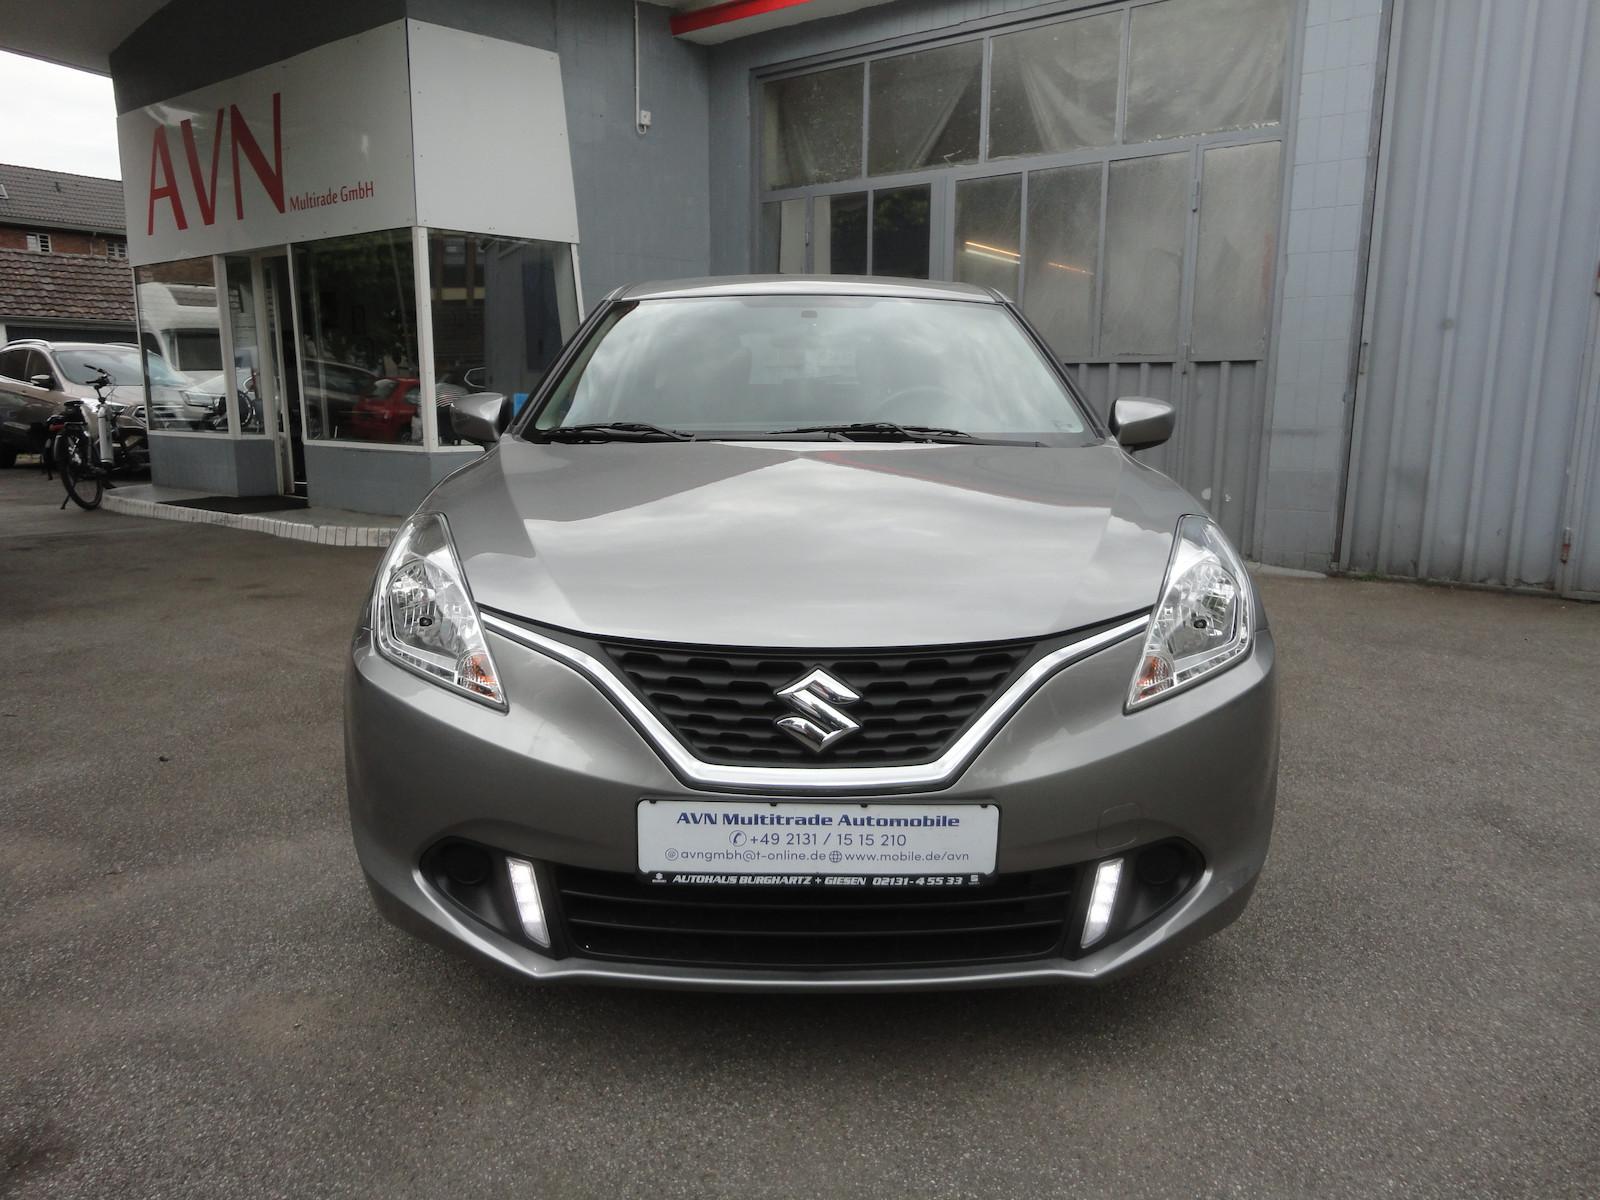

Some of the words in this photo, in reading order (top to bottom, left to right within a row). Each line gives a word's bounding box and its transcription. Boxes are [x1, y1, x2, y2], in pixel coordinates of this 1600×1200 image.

[148, 92, 285, 235] AVN
[290, 187, 338, 212] Multirade
[341, 181, 374, 202] GmbH
[676, 812, 718, 825] AVN
[723, 813, 833, 826] Multitrade
[837, 814, 960, 827] Automobile
[750, 832, 780, 846] +49
[786, 832, 817, 846] 2131
[837, 833, 853, 847] 15
[859, 833, 875, 847] 15
[880, 834, 907, 847] 210
[845, 850, 969, 862] www.mobile.de/avn
[672, 874, 737, 884] AUTOHAUS
[739, 875, 812, 885] BURGHARTZ
[824, 876, 867, 886] GIESEN
